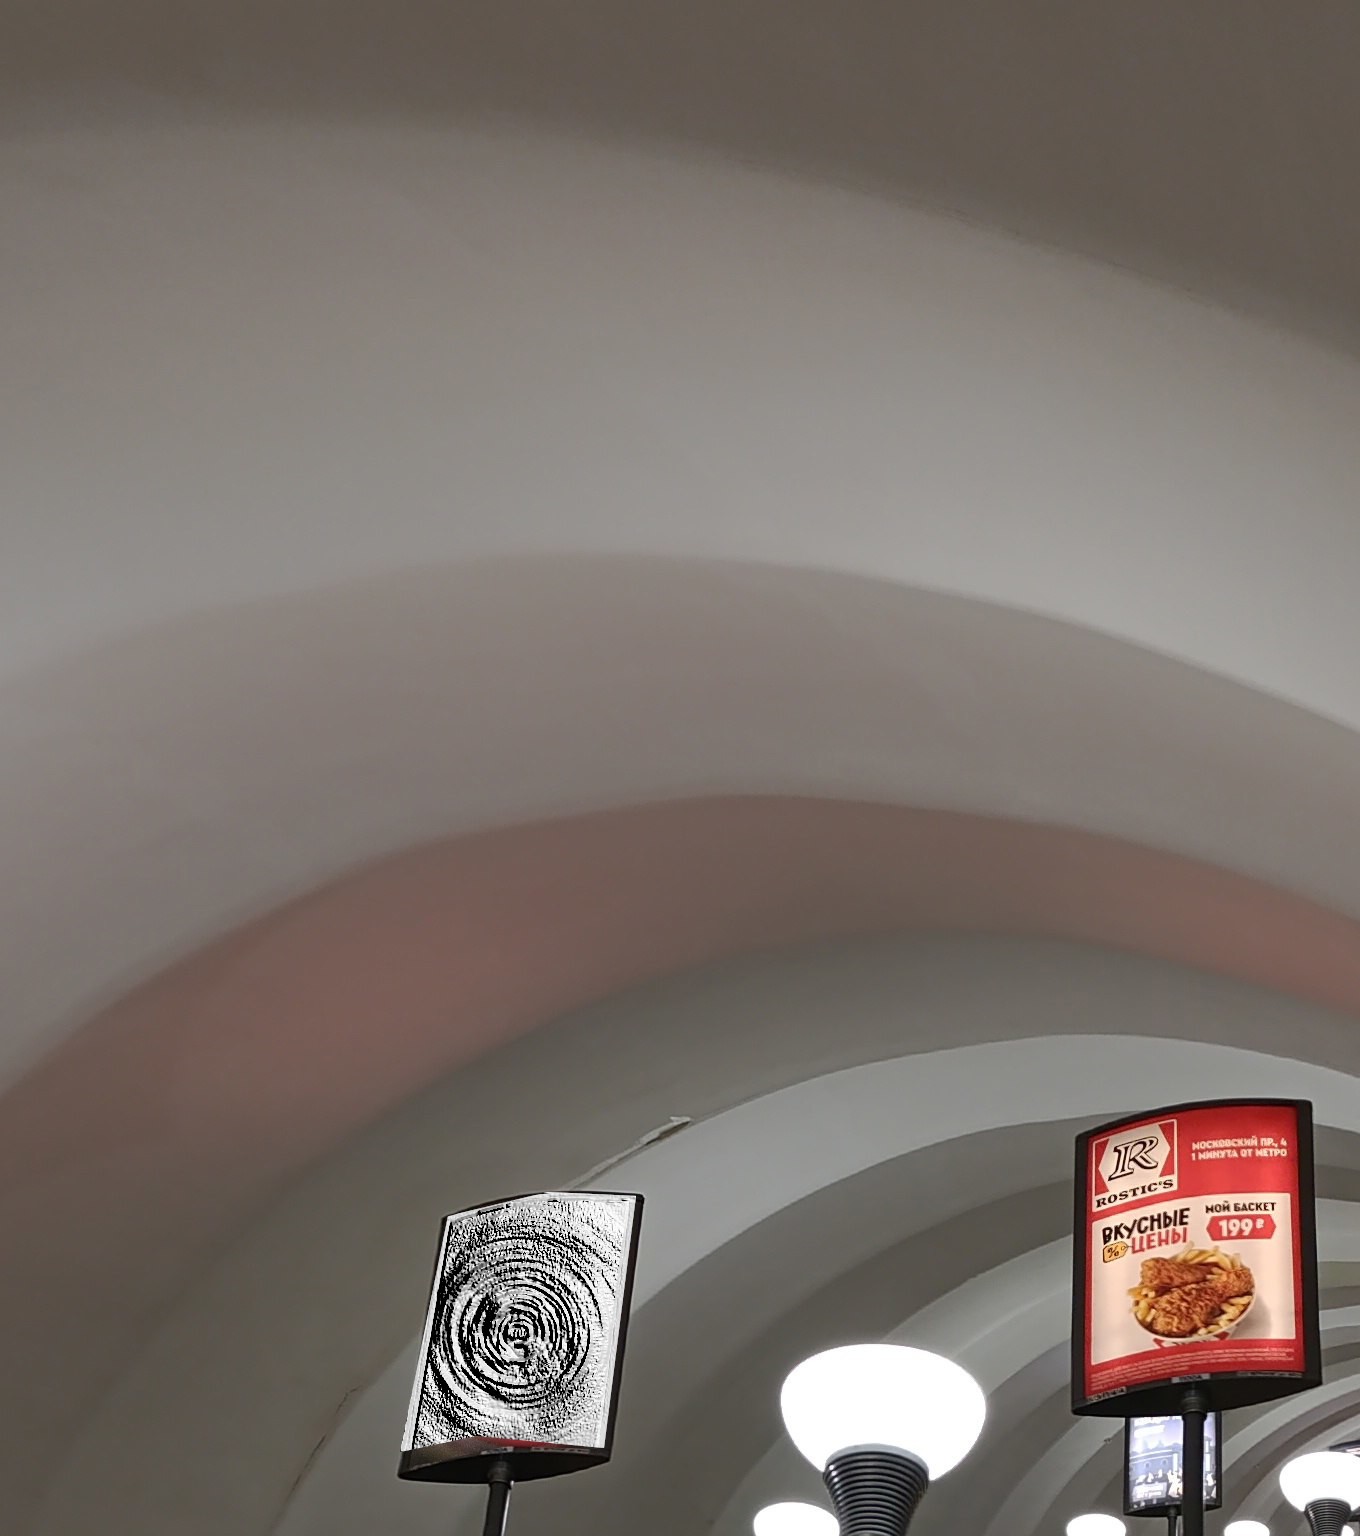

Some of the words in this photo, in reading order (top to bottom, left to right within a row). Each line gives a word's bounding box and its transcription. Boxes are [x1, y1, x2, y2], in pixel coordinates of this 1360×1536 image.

[1192, 1135, 1258, 1150] МОСКОВСКИЙ
[1280, 1137, 1288, 1147] 4
[1191, 1152, 1196, 1161] 1
[1198, 1149, 1238, 1160] МИНУТА
[1240, 1148, 1253, 1158] ОТ
[1255, 1148, 1288, 1157] МЕТРО
[1095, 1179, 1174, 1208] ROSTIC'S
[1205, 1200, 1231, 1214] МОЙ
[1233, 1202, 1277, 1212] БАСКЕТ
[1102, 1207, 1190, 1245] ВКУСНЫЕ
[1131, 1227, 1188, 1254] ЦЕНЫ
